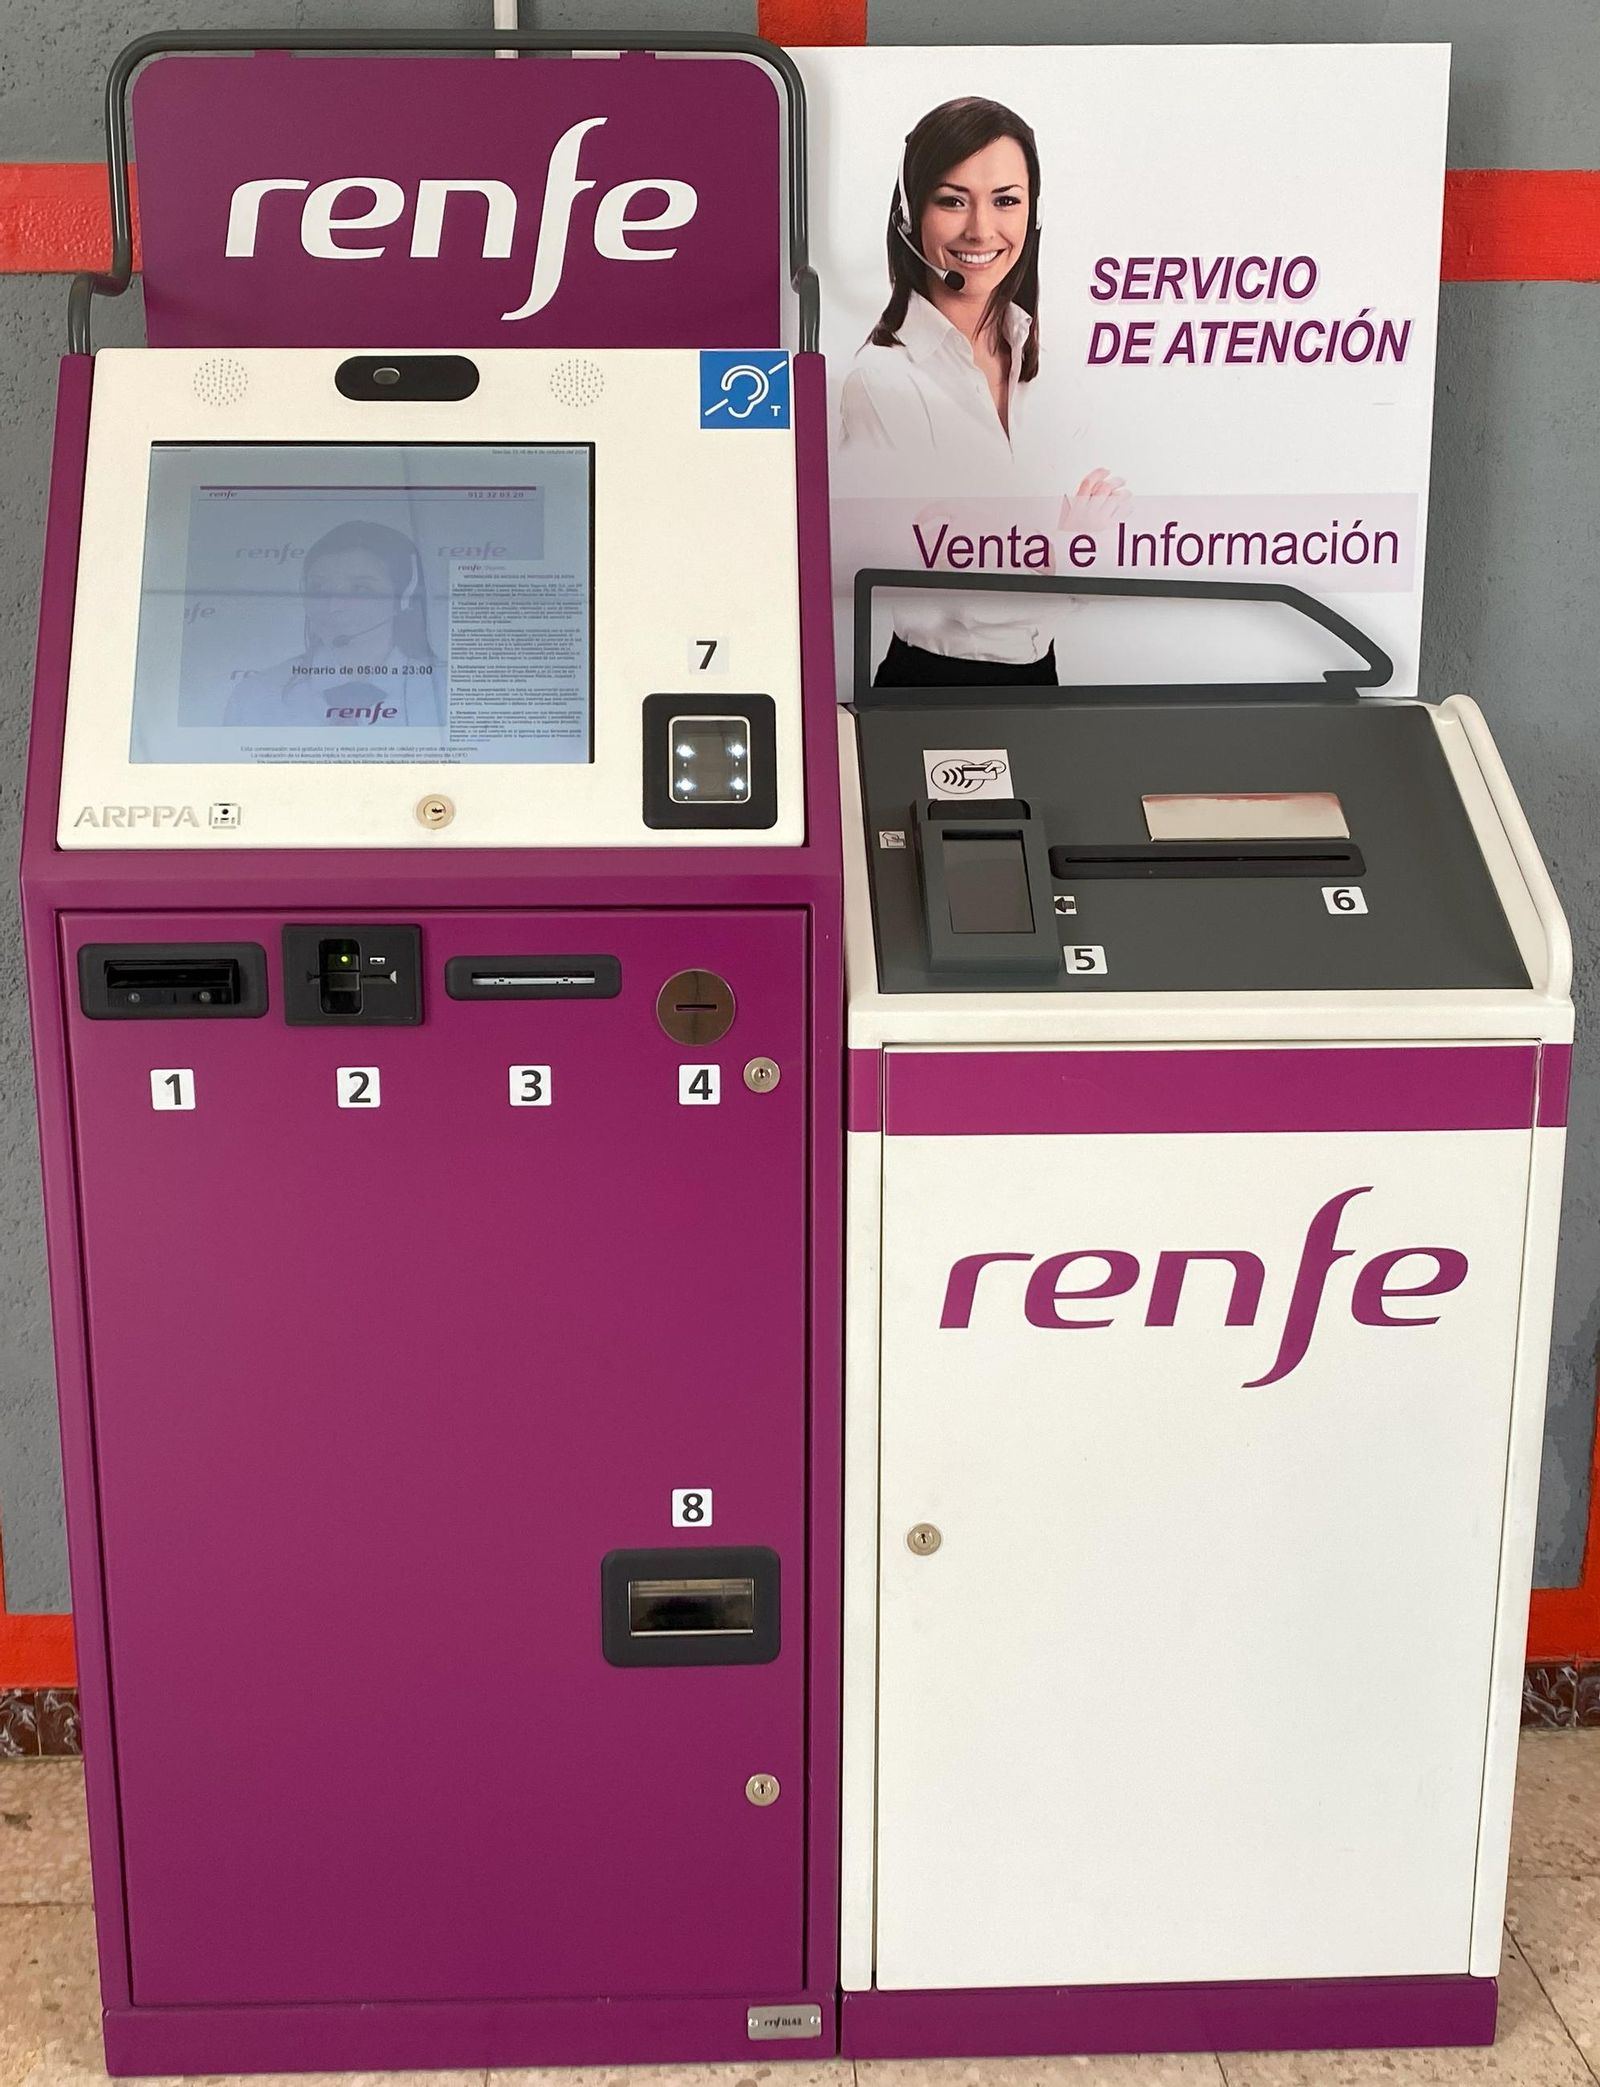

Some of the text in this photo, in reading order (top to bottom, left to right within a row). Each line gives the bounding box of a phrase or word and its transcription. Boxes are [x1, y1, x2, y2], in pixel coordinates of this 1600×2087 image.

[224, 116, 698, 322] renfe
[1090, 254, 1319, 302] SERVICIO
[1087, 307, 1412, 367] DE ATENCIÓN
[770, 404, 782, 417] T
[209, 490, 237, 500] renfe
[913, 518, 1400, 569] Venta e Información
[292, 665, 433, 675] Horario de 05:00 a 23:00
[695, 639, 718, 670] 7
[326, 700, 398, 725] renfe
[73, 805, 200, 828] ARPPA
[1333, 888, 1356, 912] 6
[1073, 947, 1096, 972] 5
[163, 1073, 182, 1106] 1
[348, 1071, 371, 1104] 2
[519, 1070, 543, 1102] 3
[687, 1069, 713, 1101] 4
[939, 1185, 1469, 1389] renfe
[681, 1492, 704, 1523] 8
